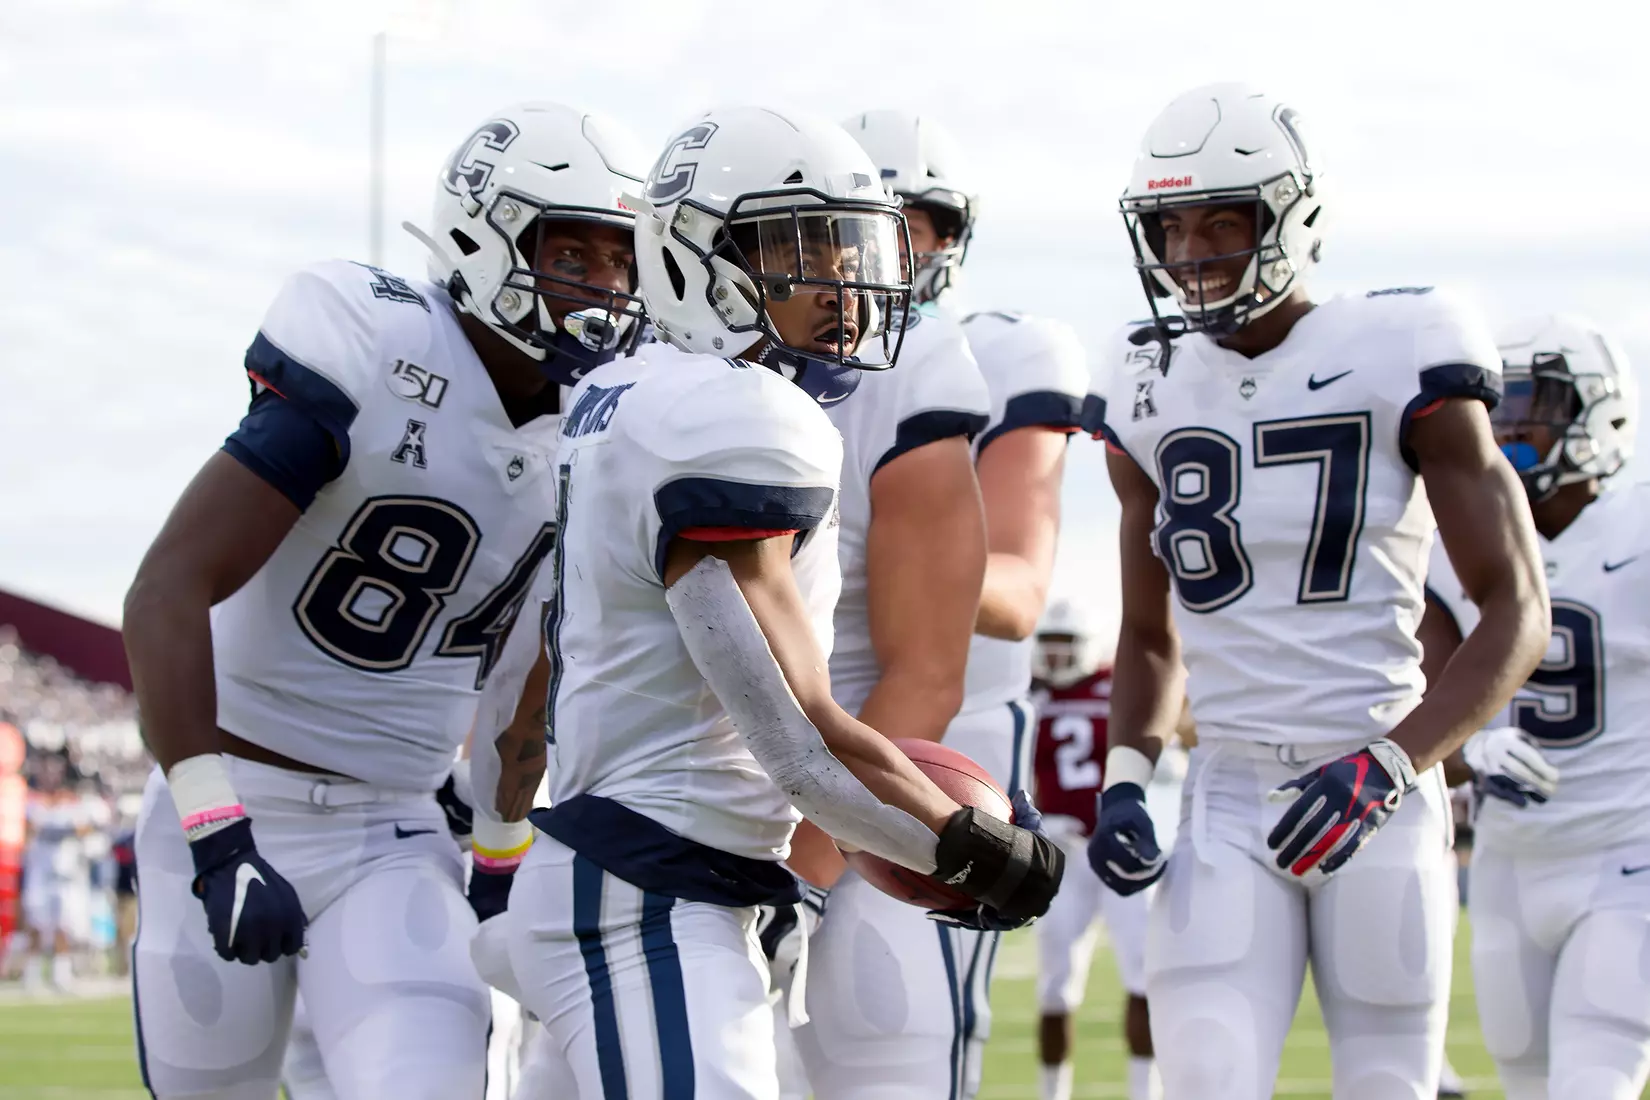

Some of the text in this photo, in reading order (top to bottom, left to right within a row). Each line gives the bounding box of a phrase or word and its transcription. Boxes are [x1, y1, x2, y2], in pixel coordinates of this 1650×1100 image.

[1147, 175, 1193, 191] Riddell
[389, 358, 449, 410] 150
[390, 418, 428, 469] A
[1151, 410, 1372, 614] 87
[1050, 715, 1100, 791] 2
